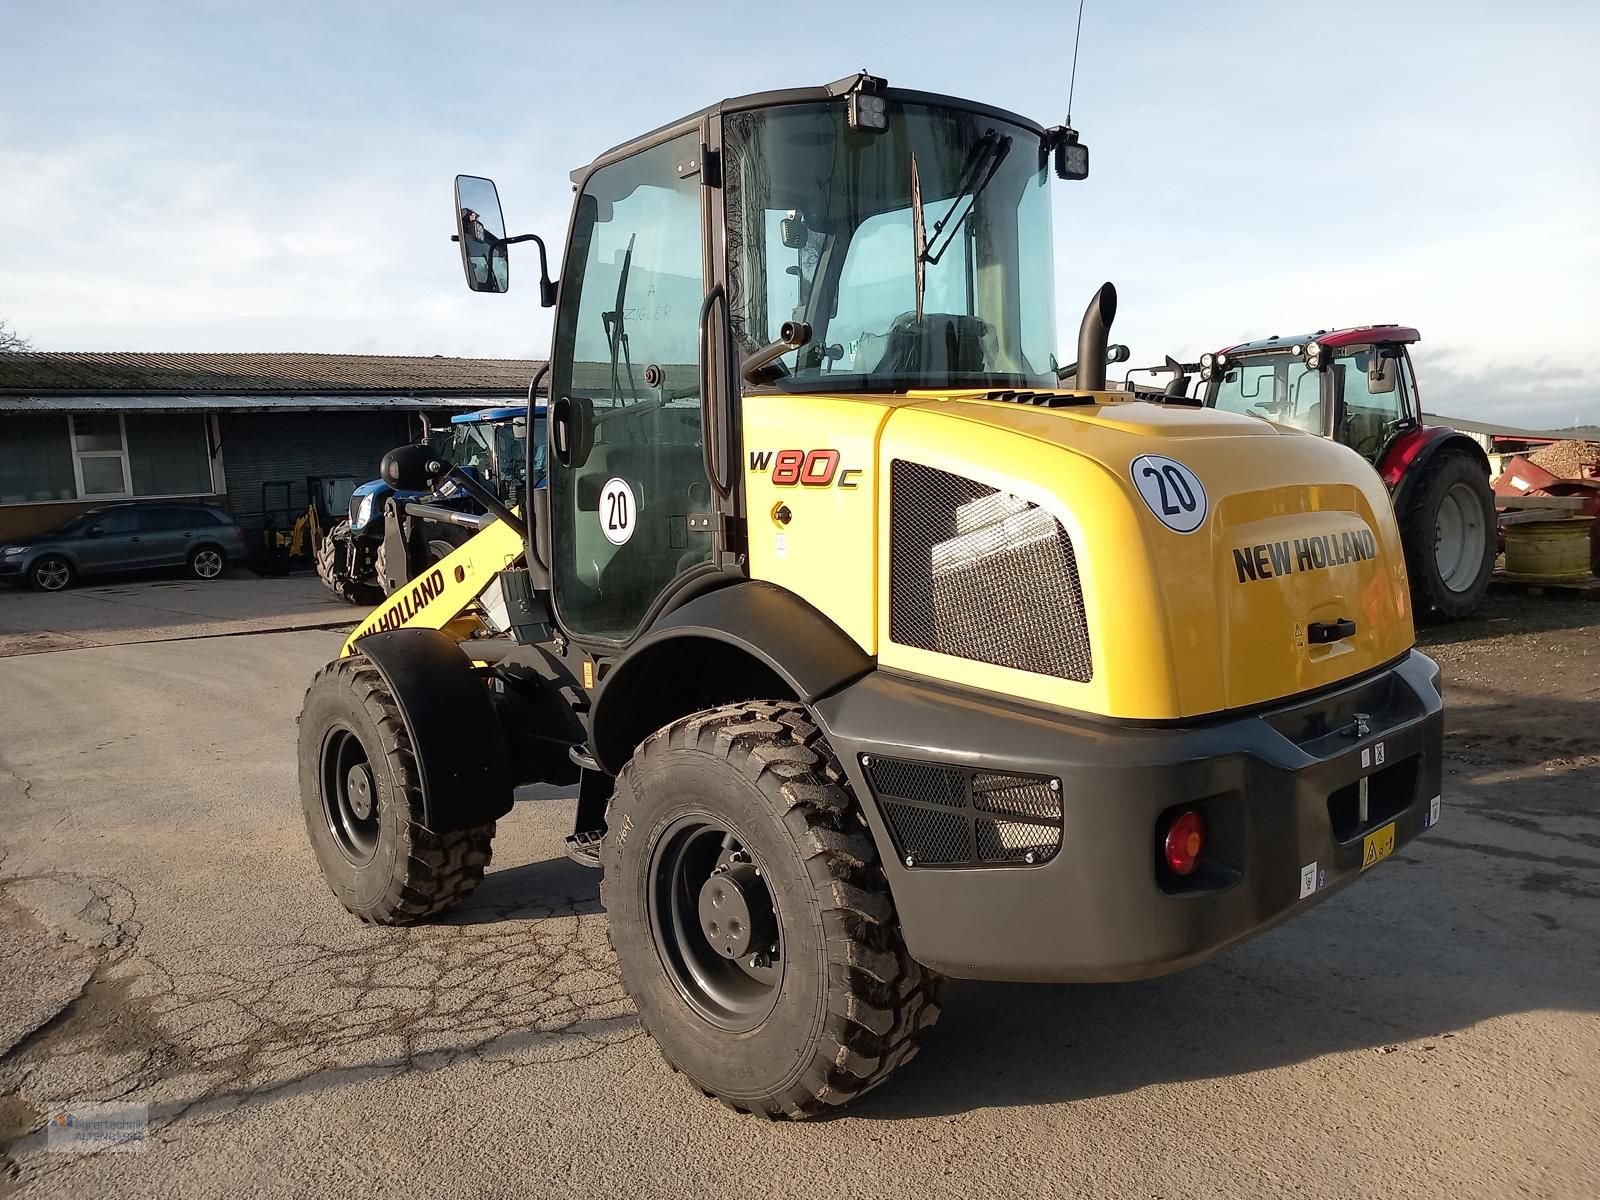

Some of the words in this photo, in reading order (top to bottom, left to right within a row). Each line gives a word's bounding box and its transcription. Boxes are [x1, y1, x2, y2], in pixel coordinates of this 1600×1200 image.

[607, 491, 627, 530] 20
[1143, 465, 1197, 516] 20
[1233, 541, 1292, 584] NEW
[1293, 530, 1376, 572] HOLLAND
[379, 569, 445, 632] HOLLAND
